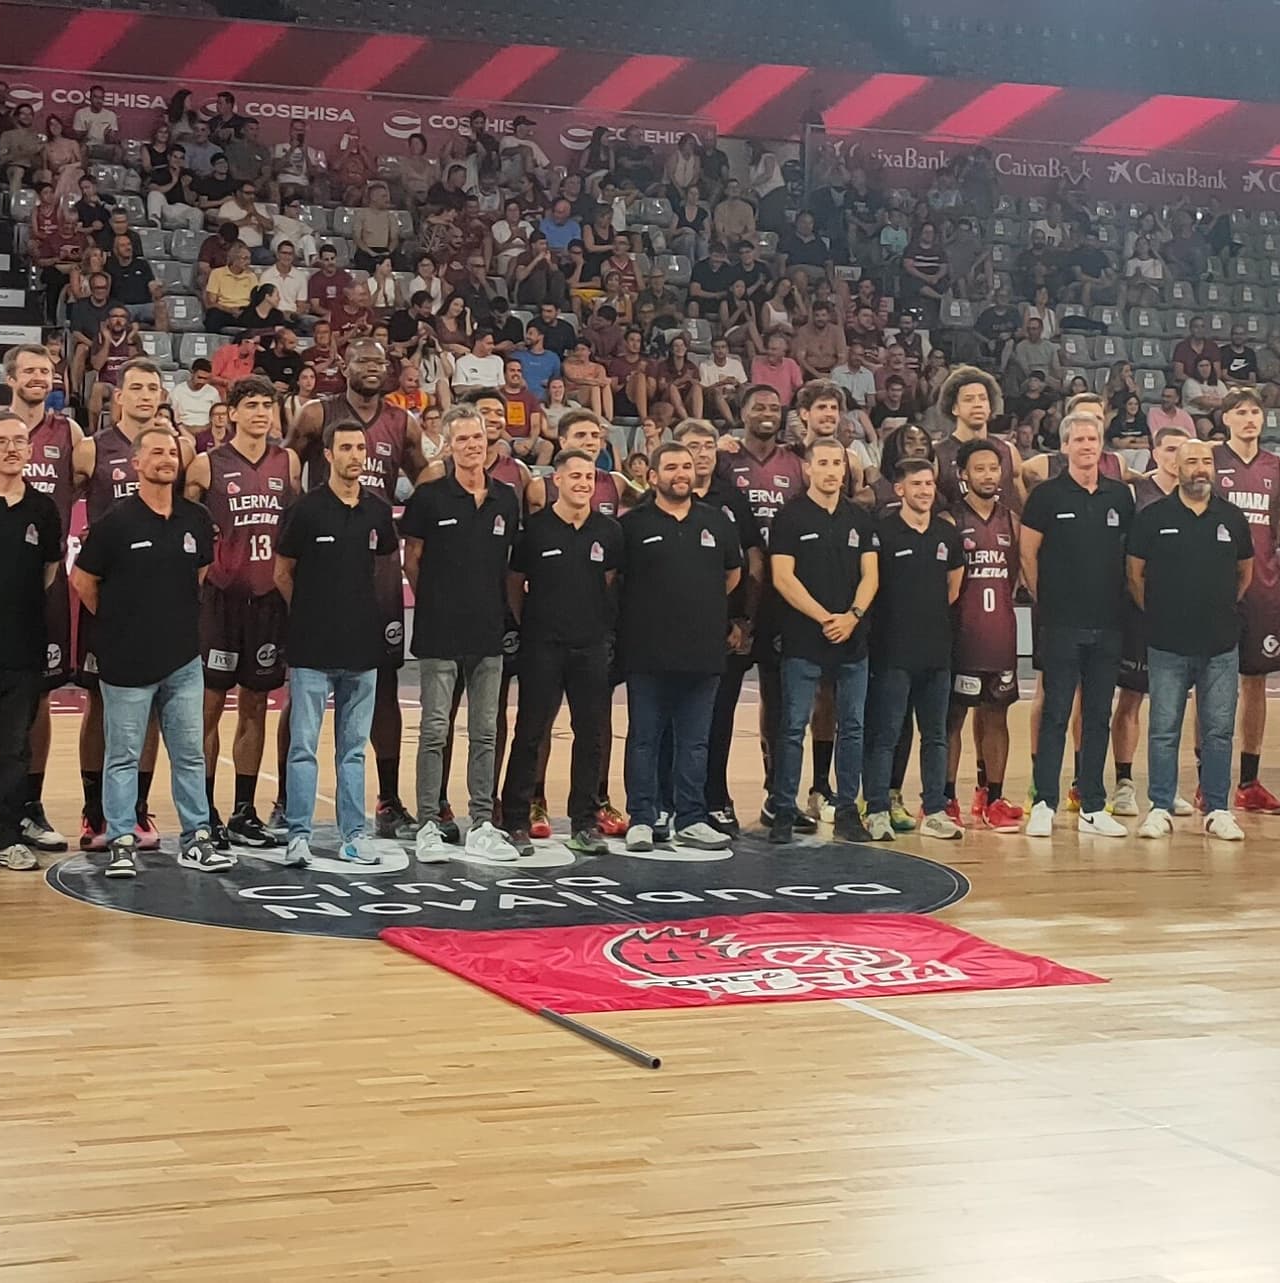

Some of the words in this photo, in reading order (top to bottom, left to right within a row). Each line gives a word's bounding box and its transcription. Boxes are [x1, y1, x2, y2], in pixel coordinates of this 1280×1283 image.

[245, 102, 356, 123] COSEHISA
[1135, 163, 1228, 190] CaixaBank
[249, 534, 272, 561] 13
[983, 588, 995, 612] 0
[263, 883, 902, 919] NovAliança
